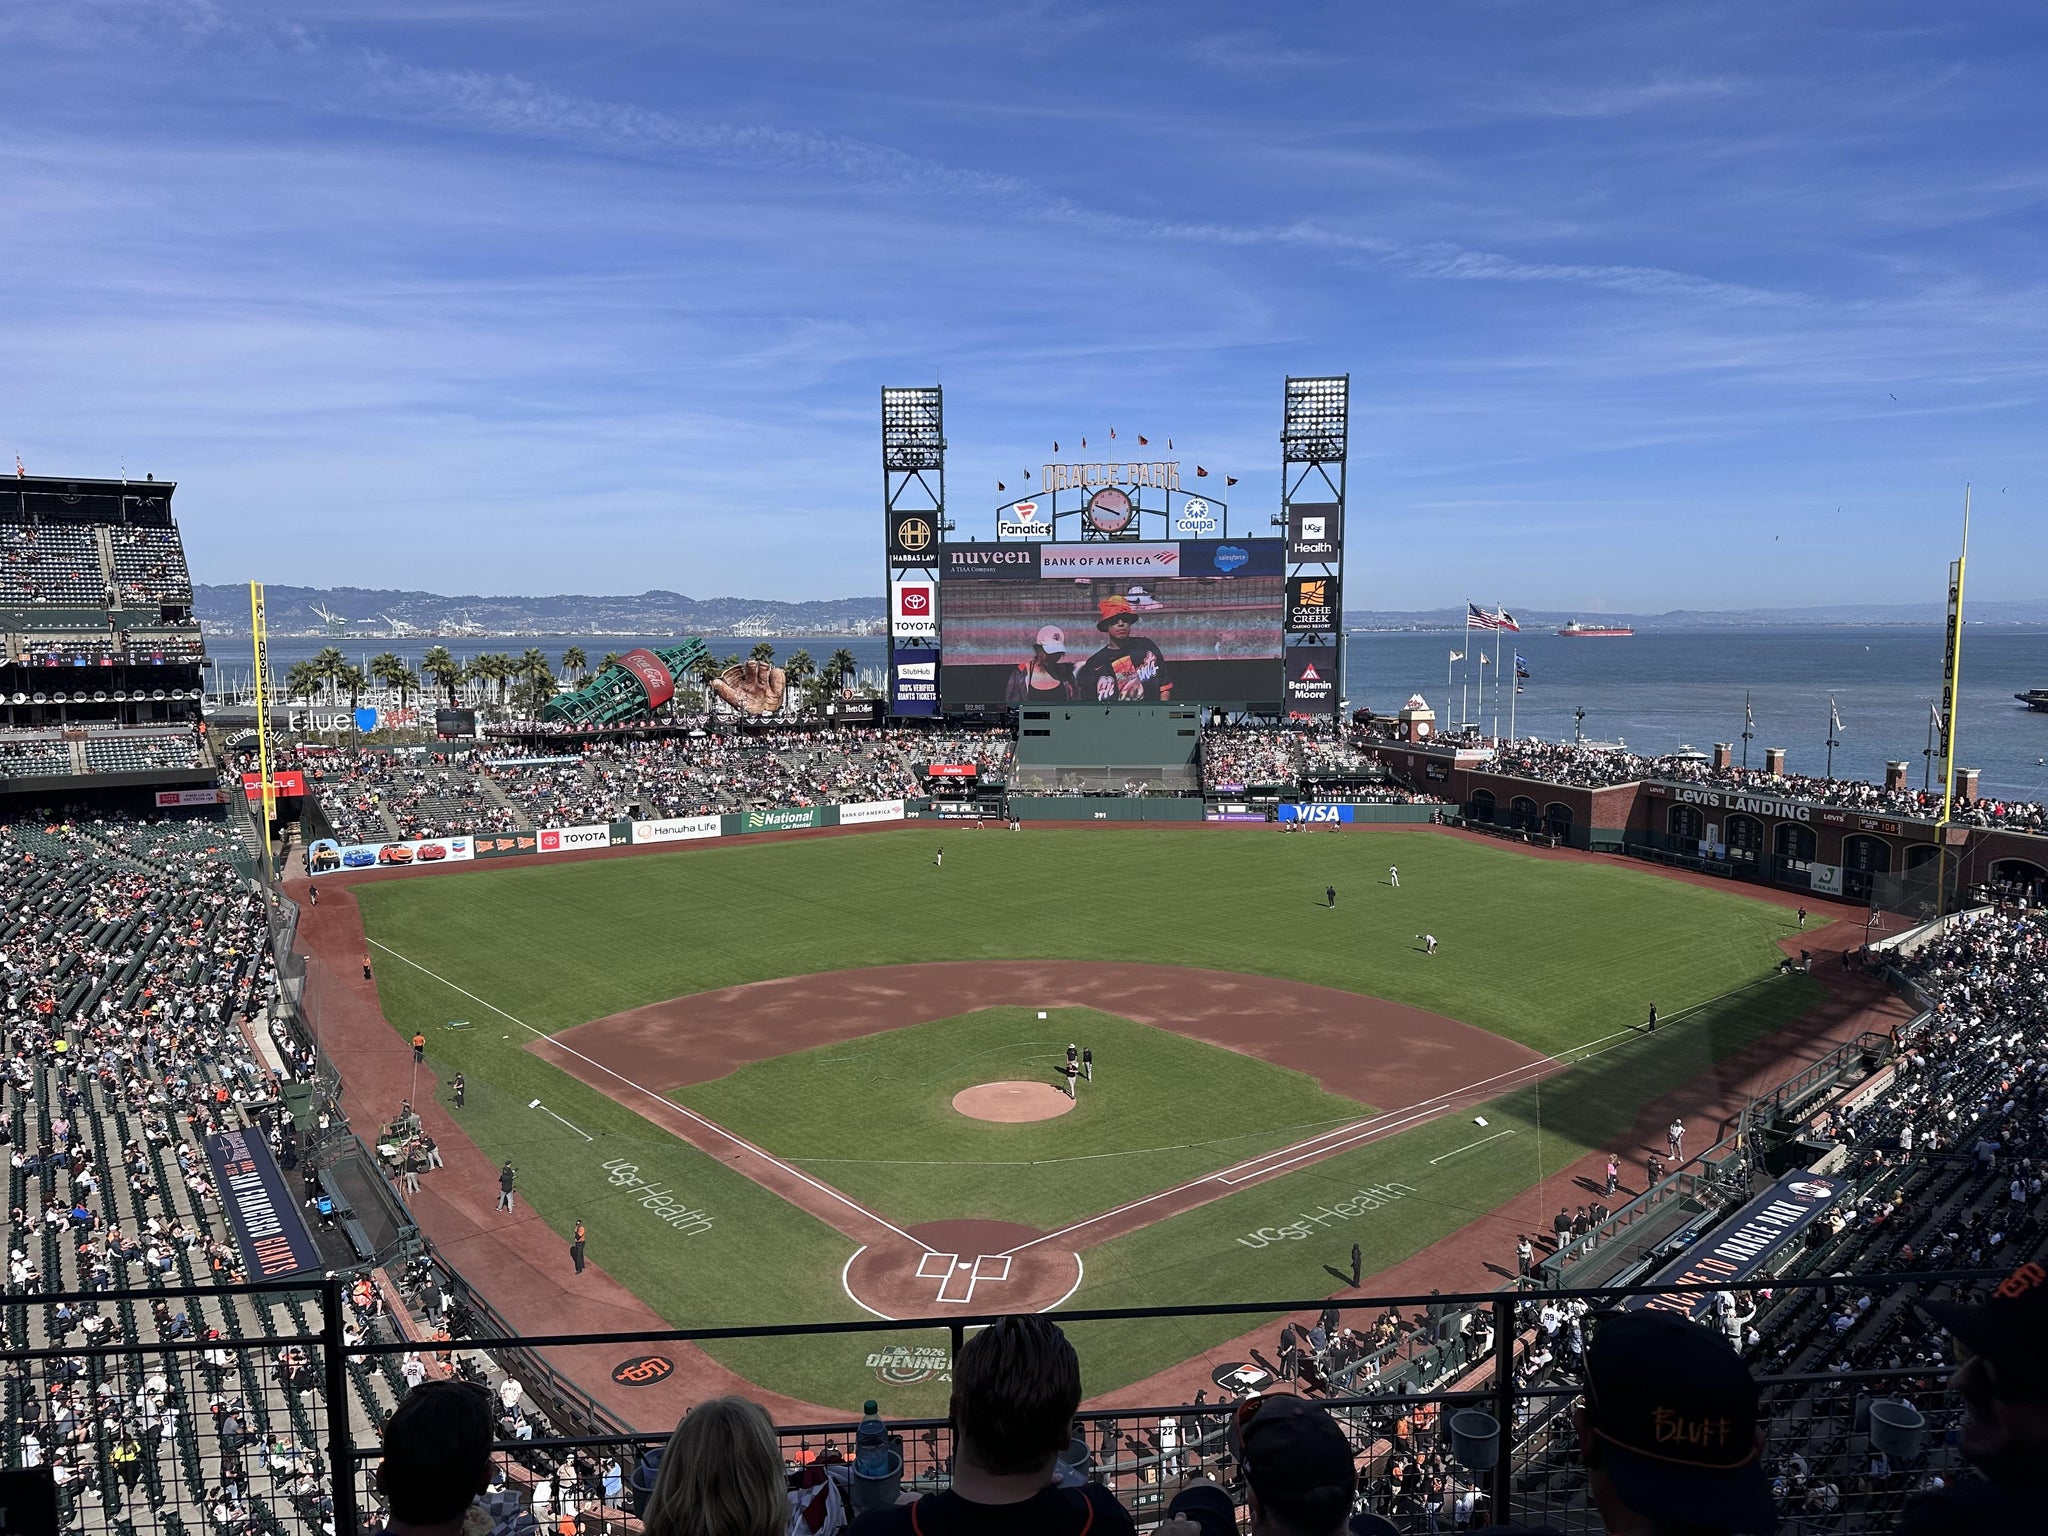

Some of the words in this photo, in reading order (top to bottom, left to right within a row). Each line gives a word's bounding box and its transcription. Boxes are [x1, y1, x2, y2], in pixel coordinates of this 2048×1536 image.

[1042, 463, 1120, 493] ORACLE
[1127, 462, 1181, 491] PARK
[1000, 522, 1052, 535] Fanatics
[1179, 519, 1213, 532] coupa
[1304, 523, 1323, 533] UCSF
[1294, 542, 1332, 553] Health
[950, 551, 1031, 564] nuveen
[1044, 557, 1076, 566] BANK
[1080, 557, 1094, 566] OF
[1097, 556, 1151, 566] AMERICA
[1292, 606, 1332, 615] CACHE
[895, 622, 936, 630] TOYOTA
[1293, 615, 1330, 623] CREEK
[258, 641, 266, 678] ROOT
[1288, 681, 1332, 692] Benjamin
[898, 692, 915, 700] GIANTS
[916, 692, 936, 700] TICKETS
[1295, 691, 1325, 699] Moore
[289, 710, 351, 733] blue
[264, 729, 273, 783] CHIKIN
[1292, 806, 1340, 822] VISA
[1725, 795, 1811, 822] LANDING
[764, 810, 814, 825] National
[654, 824, 696, 836] Hanwha
[697, 822, 717, 832] Life
[564, 832, 607, 843] TOYOTA
[228, 1171, 263, 1191] SAN
[602, 1158, 645, 1186] UCSF
[626, 1182, 716, 1236] Health
[235, 1188, 283, 1238] FRANCISCO
[1236, 1220, 1314, 1249] UCSF
[1300, 1182, 1418, 1227] Health
[1755, 1199, 1810, 1228] PARK
[1713, 1222, 1782, 1262] ORACLE
[253, 1236, 299, 1275] GIANTS
[1695, 1257, 1739, 1276] TO
[1544, 1313, 1555, 1322] 99
[914, 1347, 946, 1357] 2026
[865, 1353, 947, 1370] OPENING
